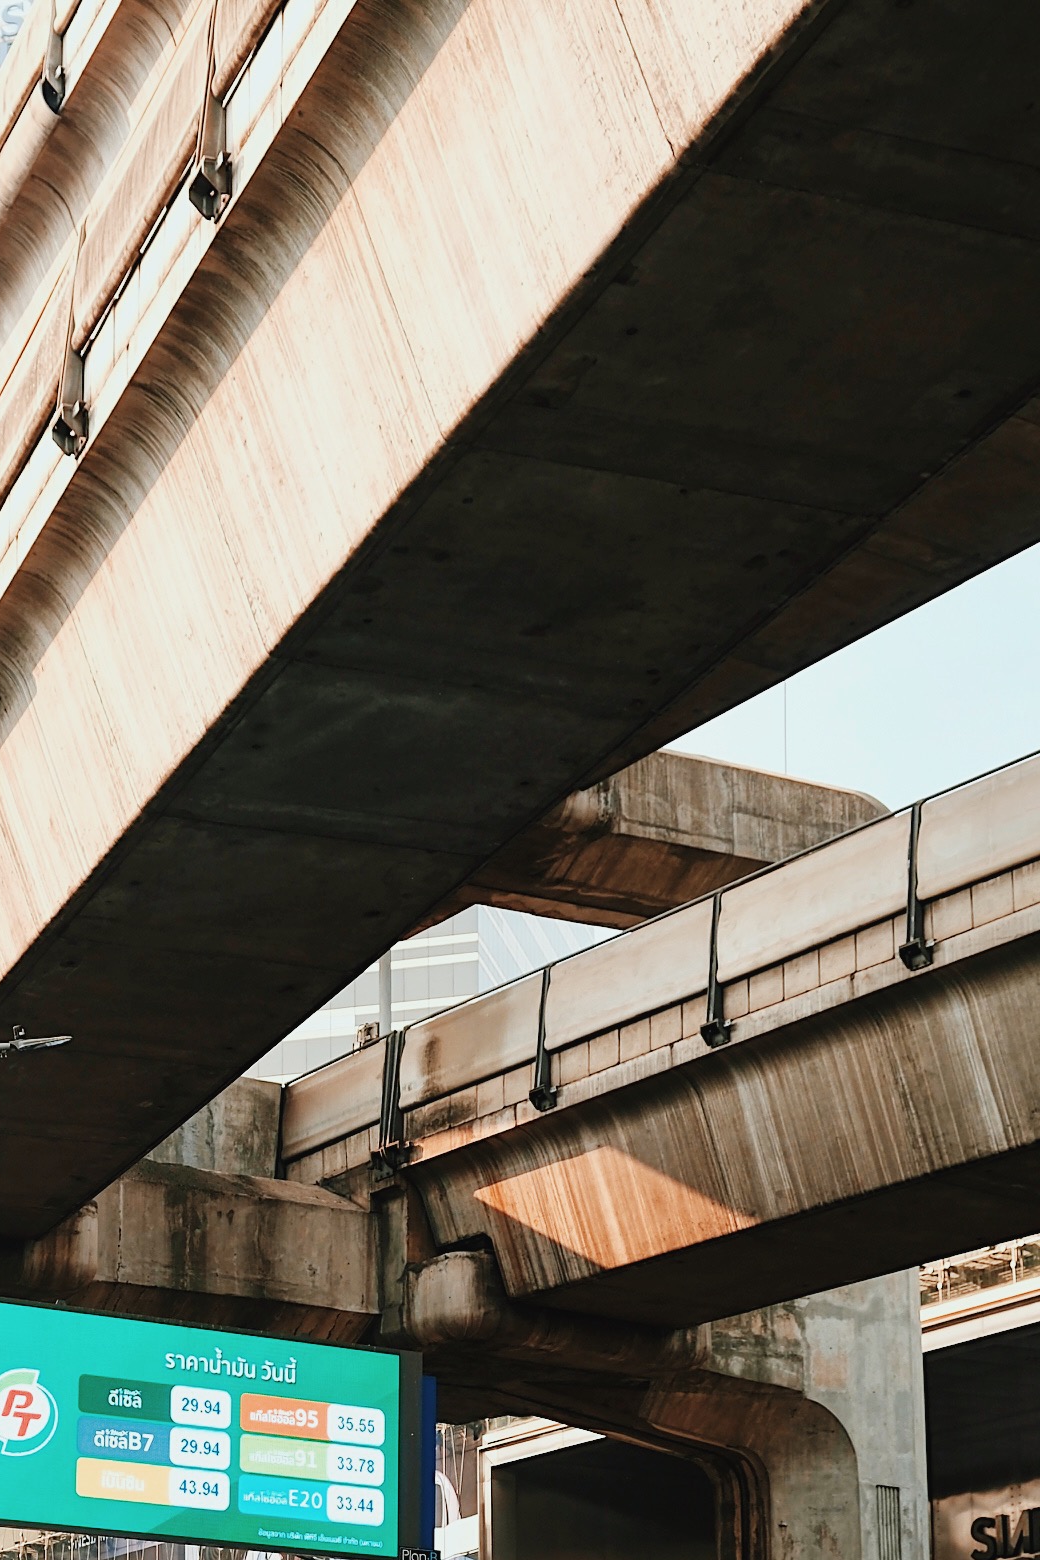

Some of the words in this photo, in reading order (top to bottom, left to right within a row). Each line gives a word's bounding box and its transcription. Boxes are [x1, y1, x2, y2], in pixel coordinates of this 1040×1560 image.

[165, 1347, 256, 1379] ราคาน้ำมัน
[261, 1357, 297, 1384] วันนี้
[1, 1389, 42, 1437] PT
[181, 1397, 221, 1415] 29.94
[337, 1416, 375, 1434] 35.55
[180, 1438, 220, 1456] 29.94
[337, 1456, 375, 1474] 33.78
[179, 1479, 219, 1497] 43.94
[336, 1496, 374, 1513] 33.44
